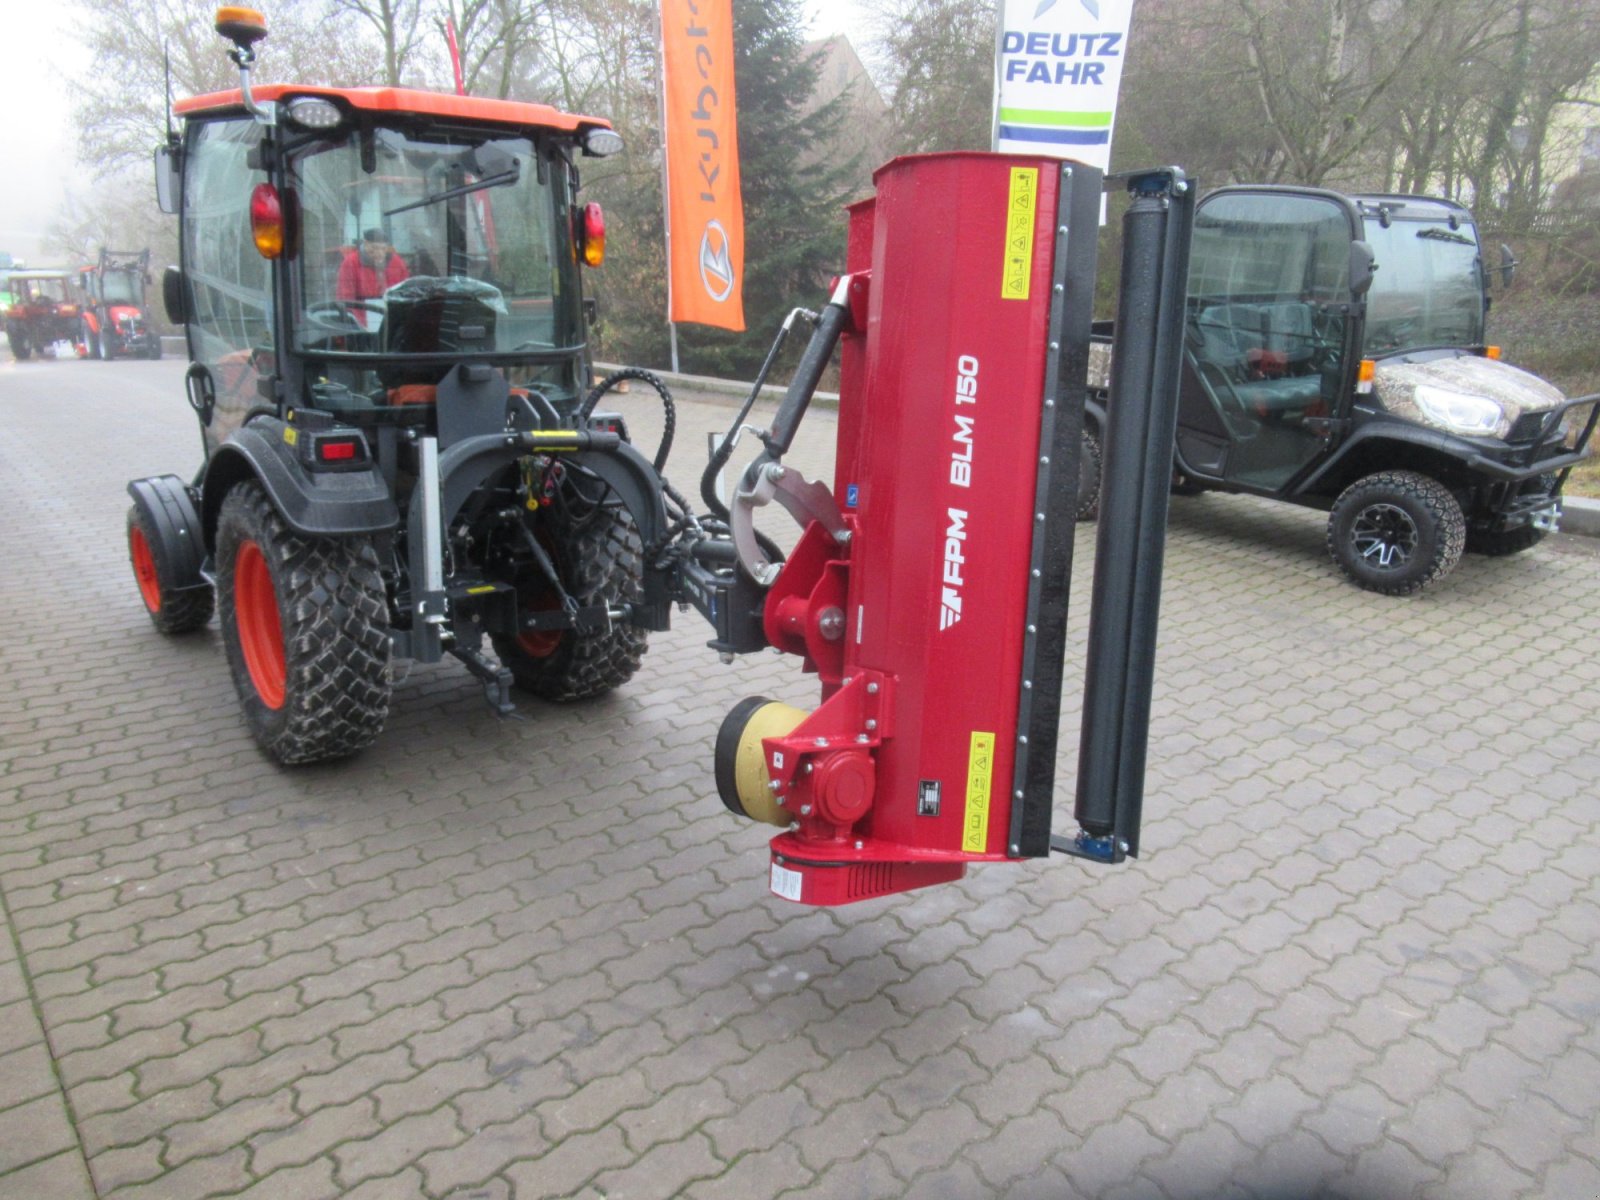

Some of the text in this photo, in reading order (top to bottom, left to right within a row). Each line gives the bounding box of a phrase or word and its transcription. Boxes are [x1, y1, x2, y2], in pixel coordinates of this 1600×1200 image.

[1002, 31, 1123, 57] DEUTZ
[1006, 59, 1106, 85] FAHR
[943, 354, 979, 587] FPM BLM 150
